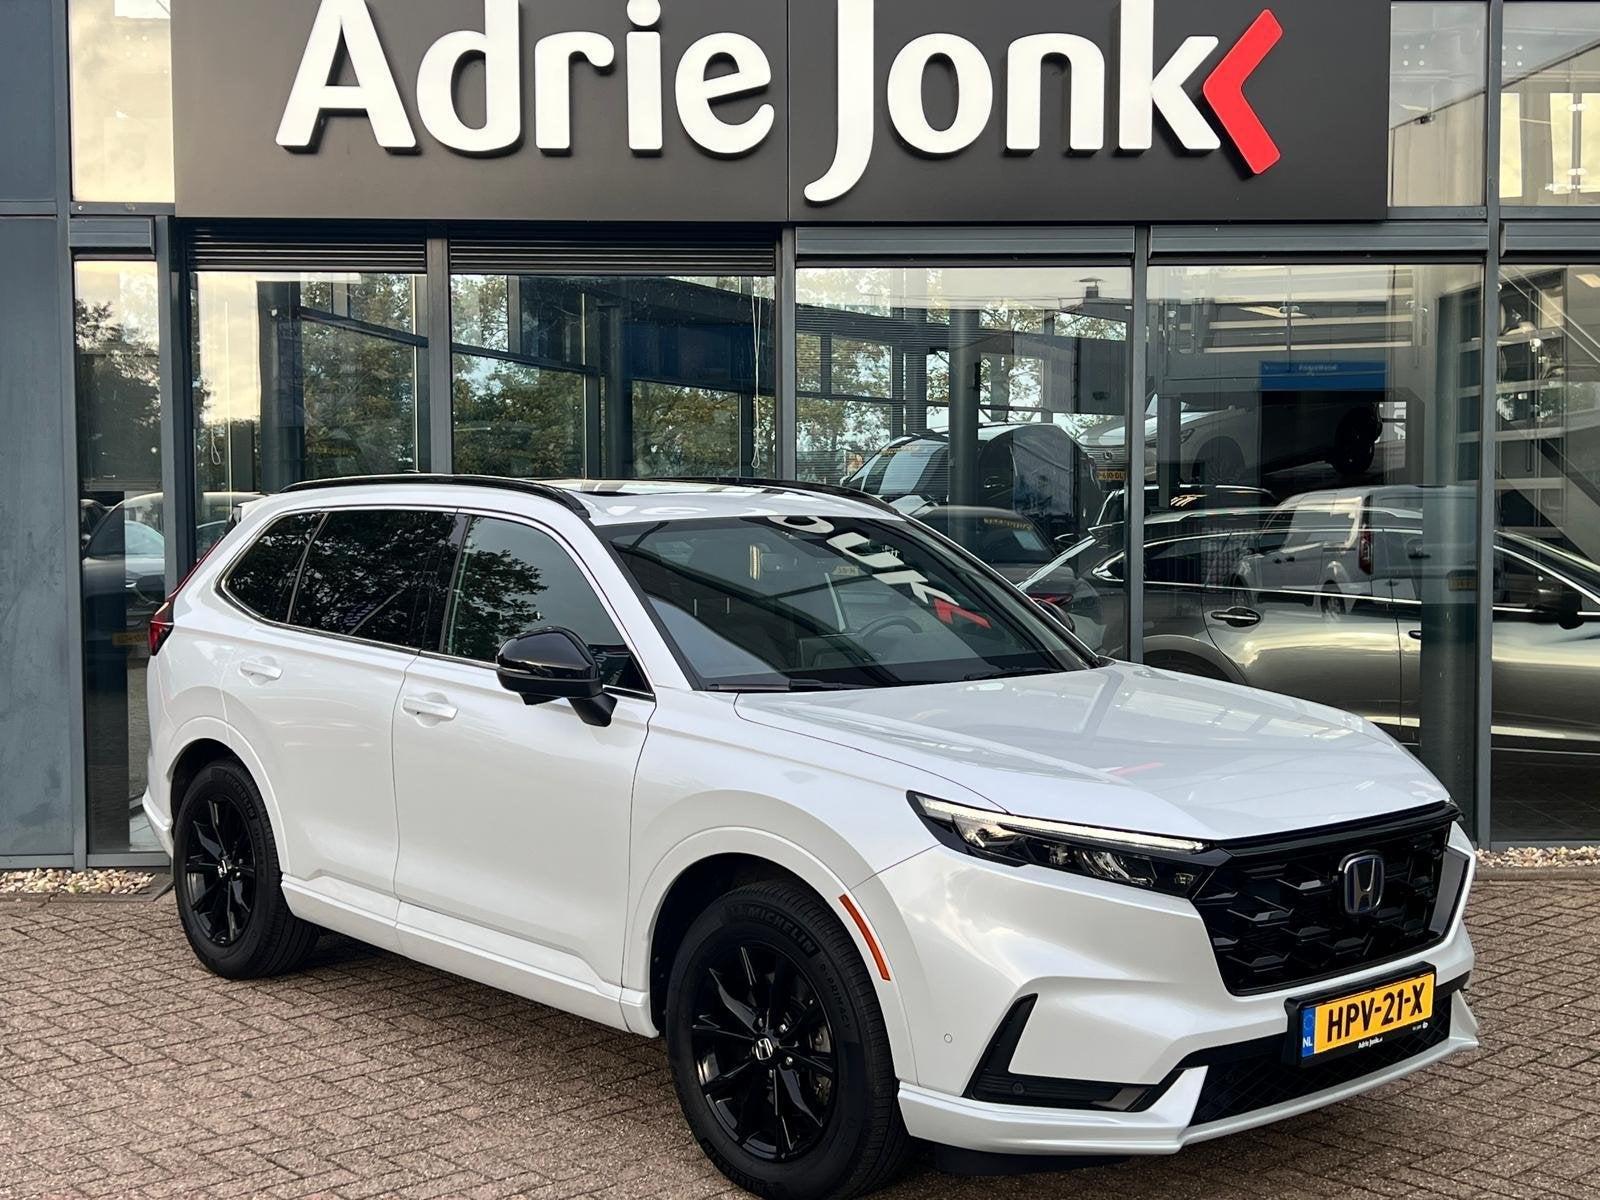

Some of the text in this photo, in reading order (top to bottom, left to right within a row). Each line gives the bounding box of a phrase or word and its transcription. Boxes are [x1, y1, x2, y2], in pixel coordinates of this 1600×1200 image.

[275, 0, 1222, 204] Adrie Jonk
[748, 905, 818, 957] MICHELIN
[1326, 981, 1426, 1043] HPV-21-X
[1302, 1036, 1313, 1048] NL
